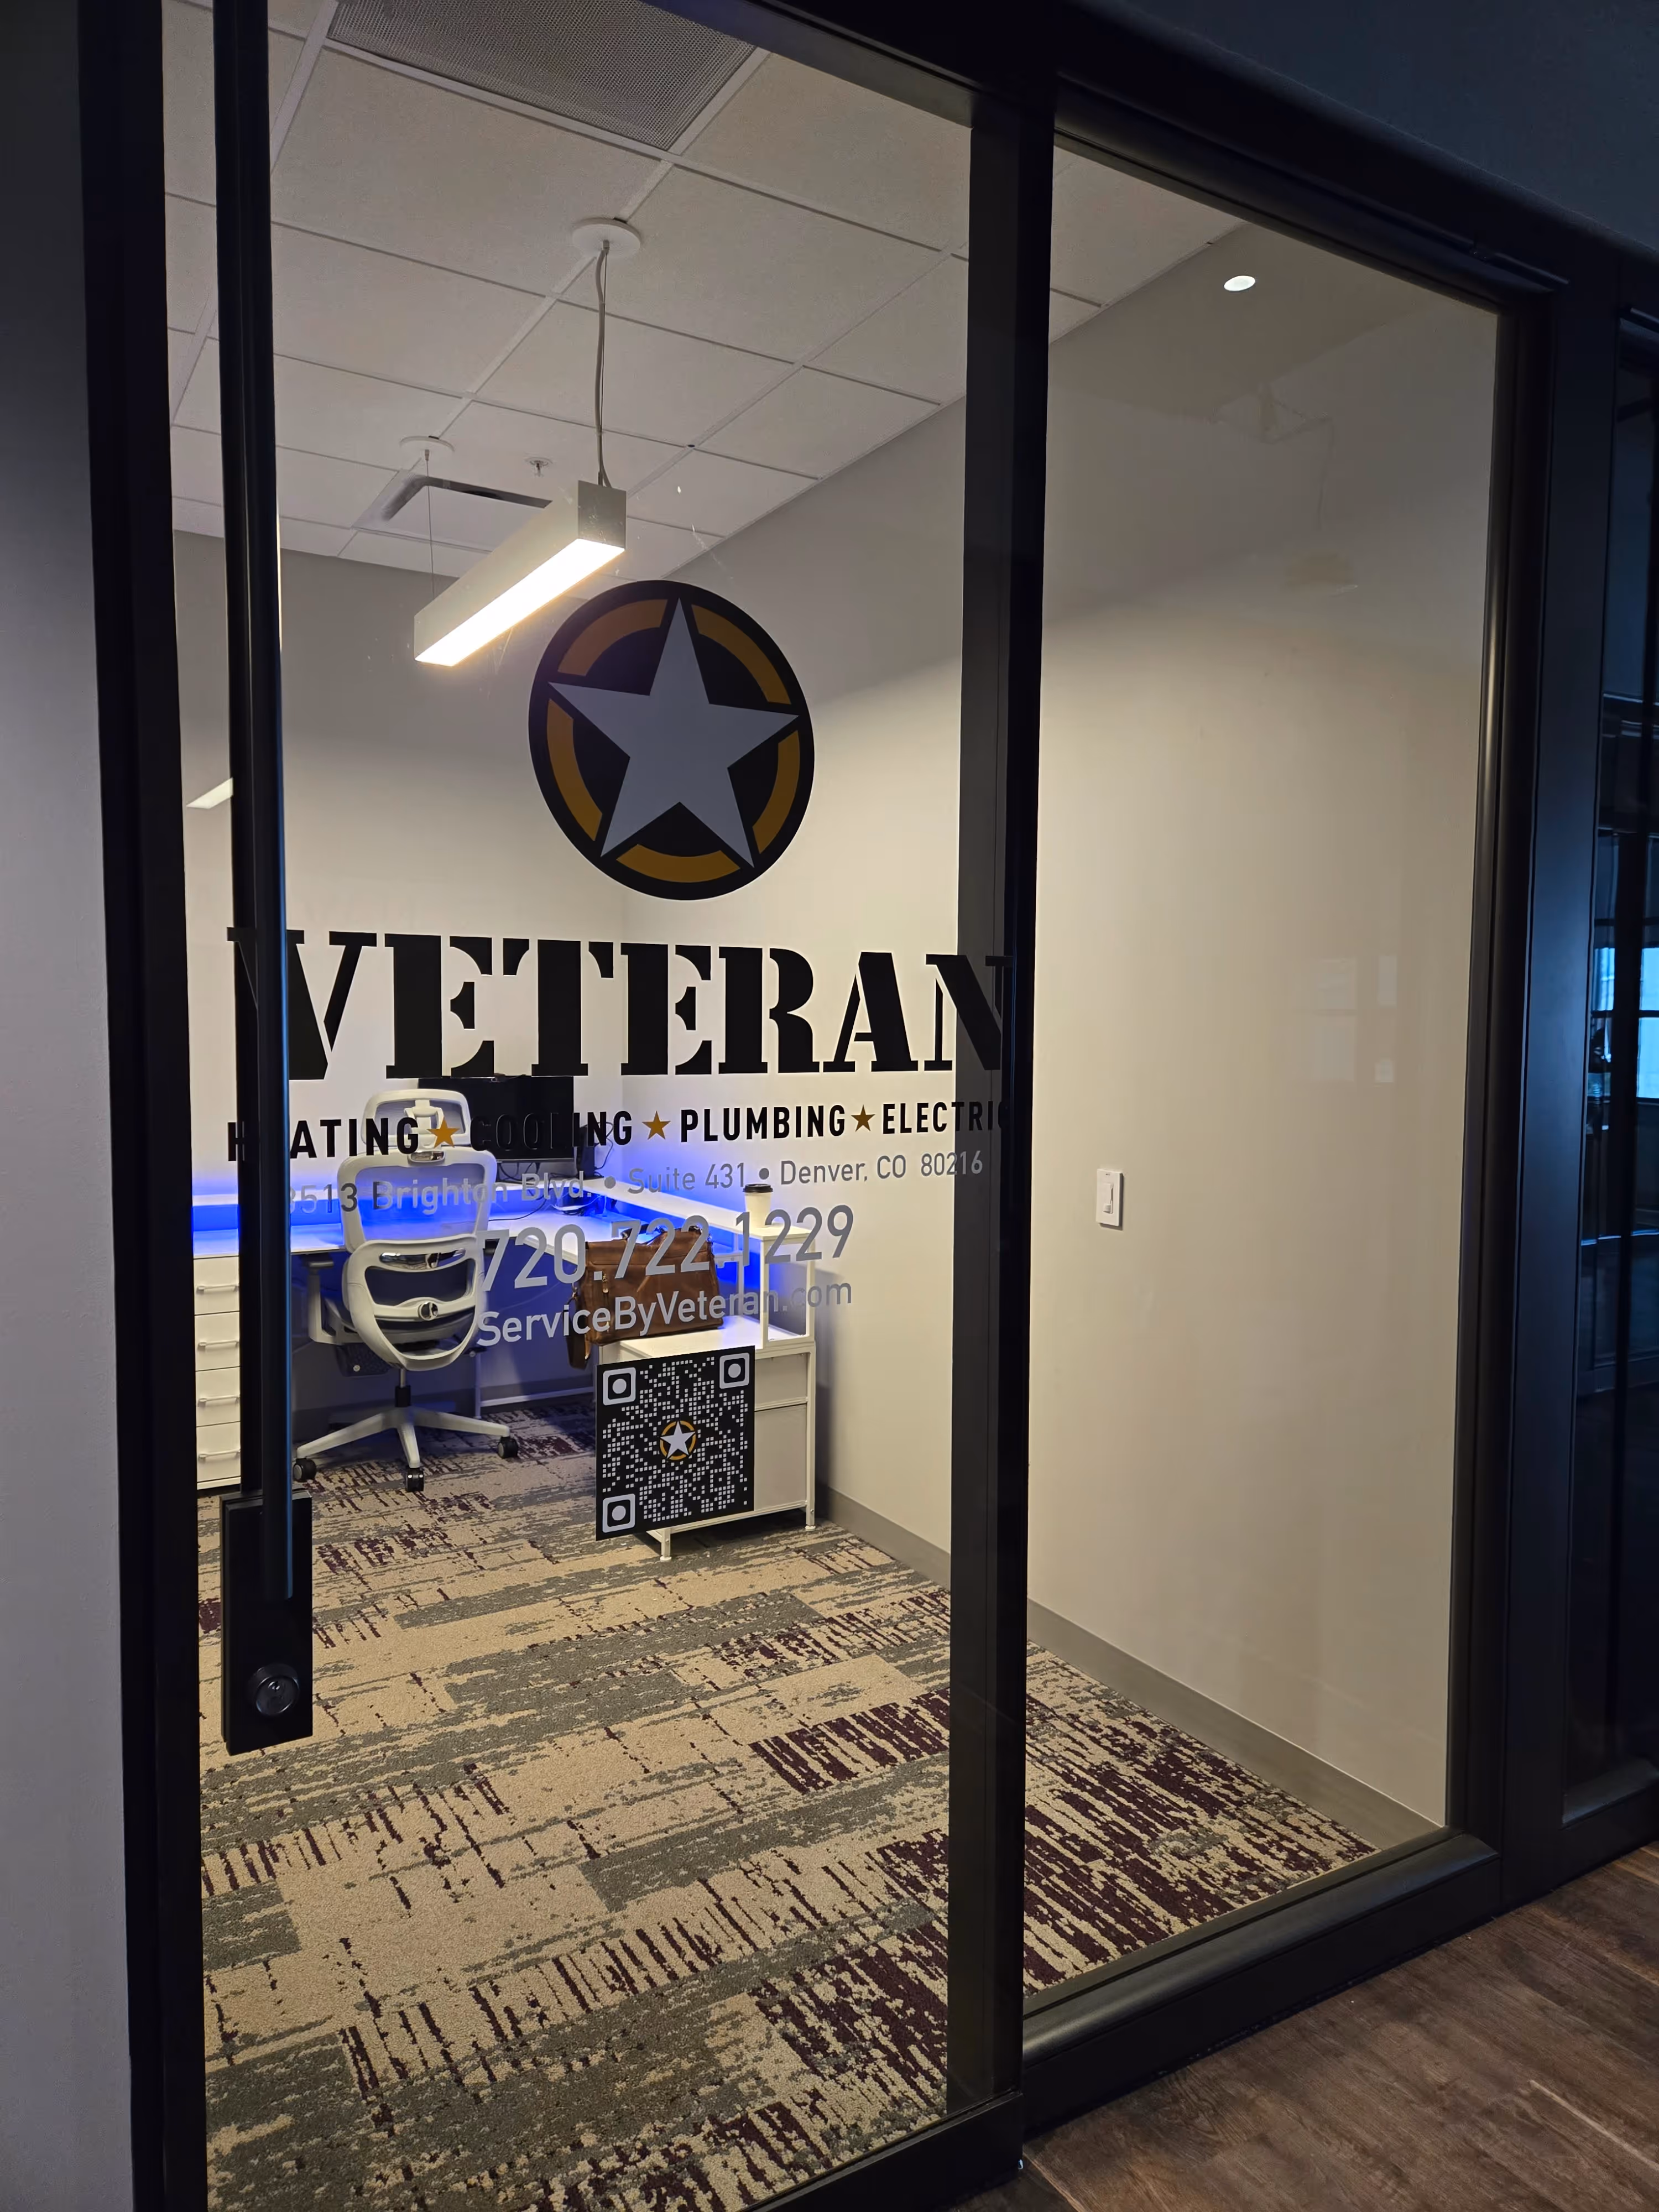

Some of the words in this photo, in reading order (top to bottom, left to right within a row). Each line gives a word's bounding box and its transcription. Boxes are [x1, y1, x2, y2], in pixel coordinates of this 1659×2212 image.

[227, 927, 1014, 1080] VETERAN
[227, 1117, 420, 1161] HATING
[470, 1110, 632, 1151] COOLING
[680, 1104, 846, 1143] PLUMBING
[883, 1101, 1004, 1135] ELECTRI
[372, 1177, 508, 1215] Brighton
[521, 1170, 592, 1201] Blvd.
[627, 1167, 695, 1194] Suite
[704, 1162, 746, 1189] 431
[780, 1160, 868, 1185] Denver,
[877, 1154, 906, 1179] CO
[920, 1150, 983, 1177] 80216
[476, 1204, 854, 1292] 720.722.1229
[476, 1282, 852, 1347] ServiceByVeteran.com
